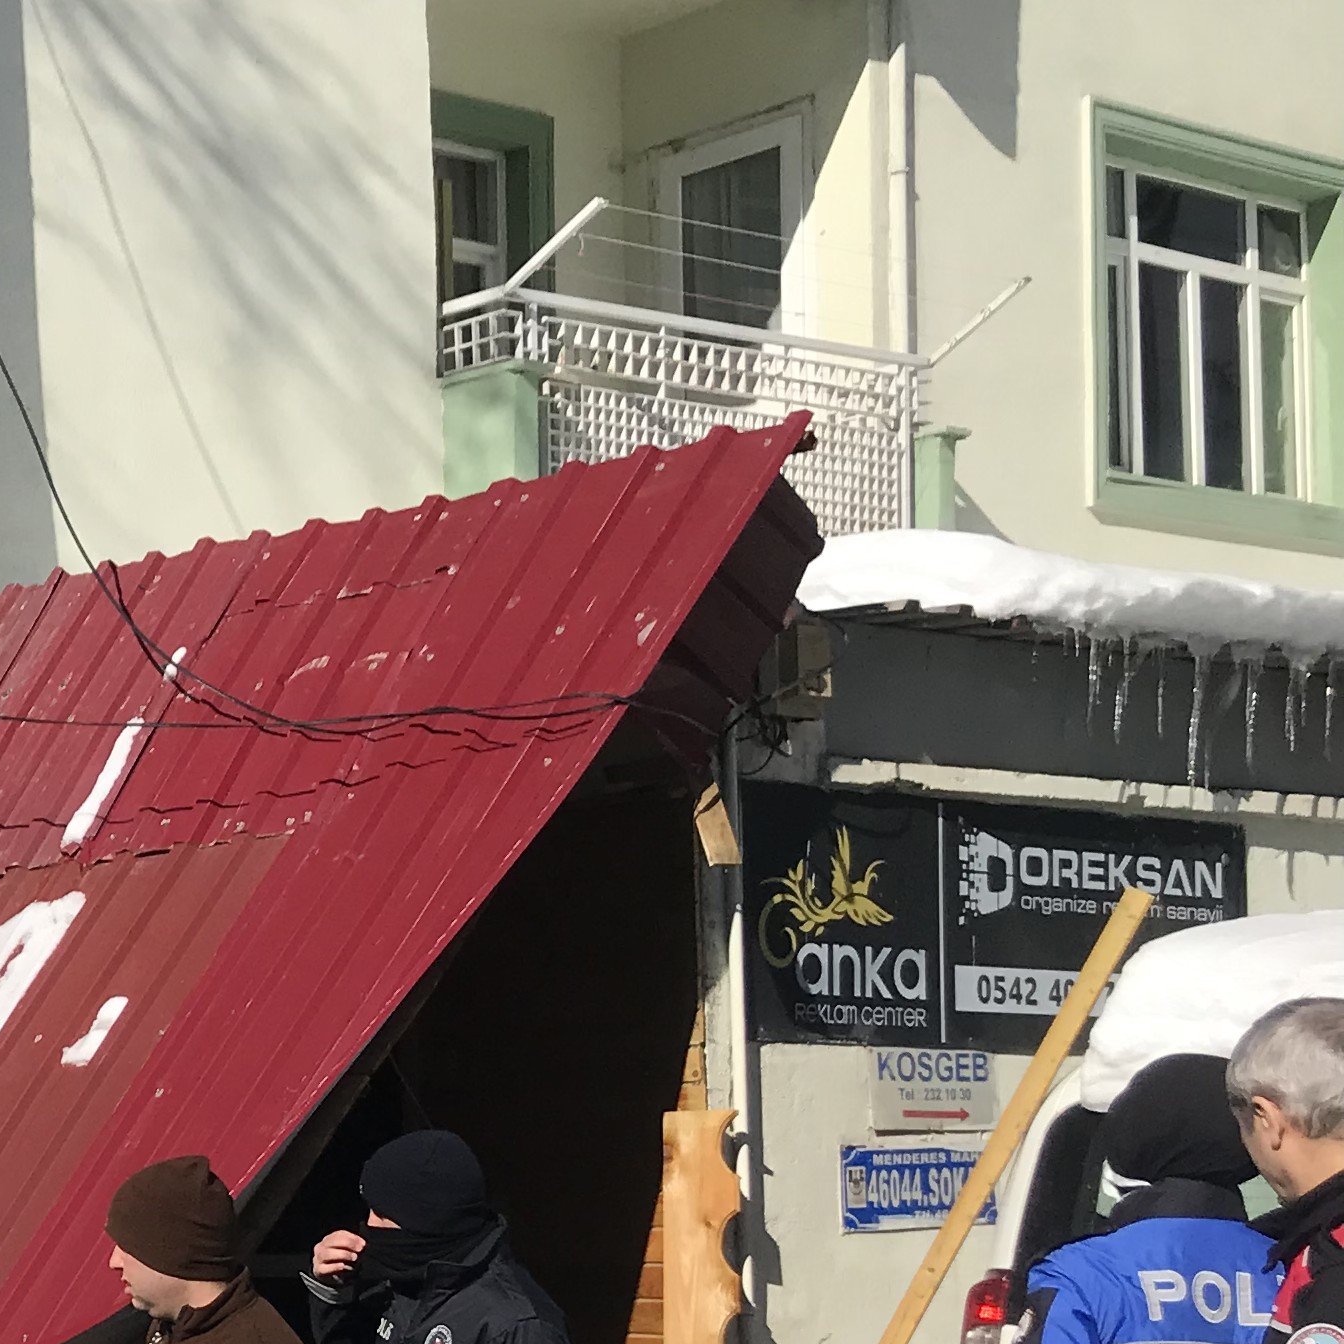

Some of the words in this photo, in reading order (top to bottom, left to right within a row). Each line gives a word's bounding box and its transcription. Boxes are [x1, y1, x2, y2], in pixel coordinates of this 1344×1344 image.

[1020, 894, 1097, 916] organize
[1166, 904, 1224, 922] sanayii
[796, 942, 927, 1001] anka
[976, 974, 1039, 1006] 0542
[877, 1051, 990, 1083] KOSGEB
[923, 1087, 942, 1101] 232
[872, 1152, 947, 1166] MENDERES
[867, 1167, 976, 1208] 46044.SOK
[1137, 1269, 1282, 1327] POL
